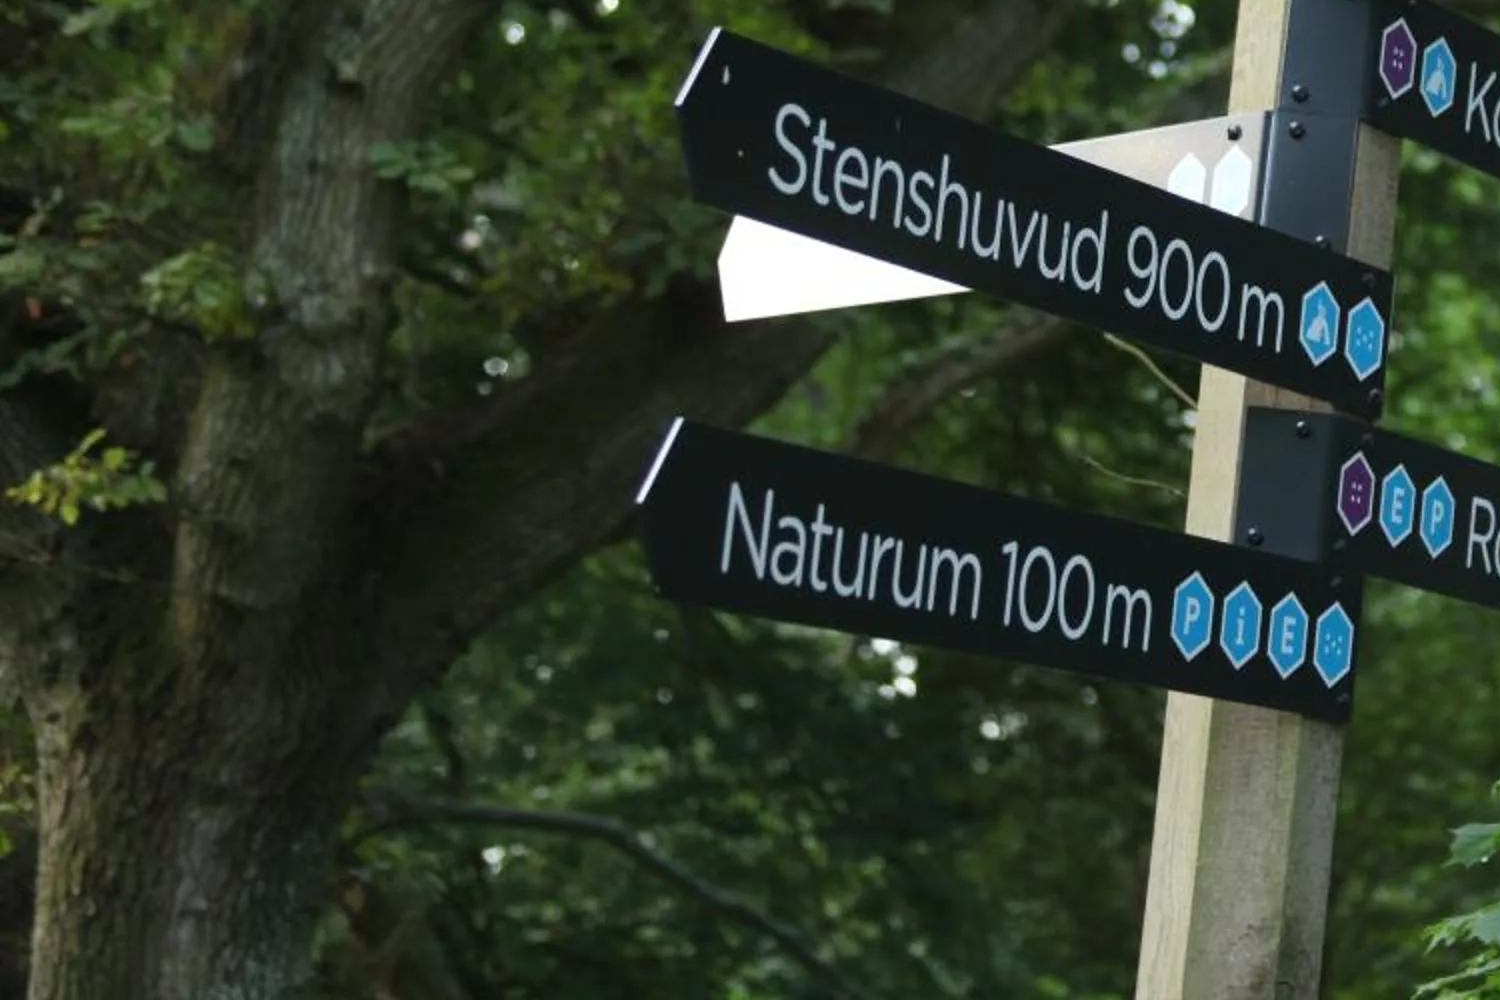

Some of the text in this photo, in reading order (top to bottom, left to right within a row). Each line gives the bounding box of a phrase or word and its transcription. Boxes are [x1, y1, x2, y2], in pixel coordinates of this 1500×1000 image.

[767, 102, 1285, 353] Stenshuvud 900 m
[721, 481, 982, 621] Naturum
[1002, 540, 1095, 640] 100
[1102, 583, 1153, 652] m
